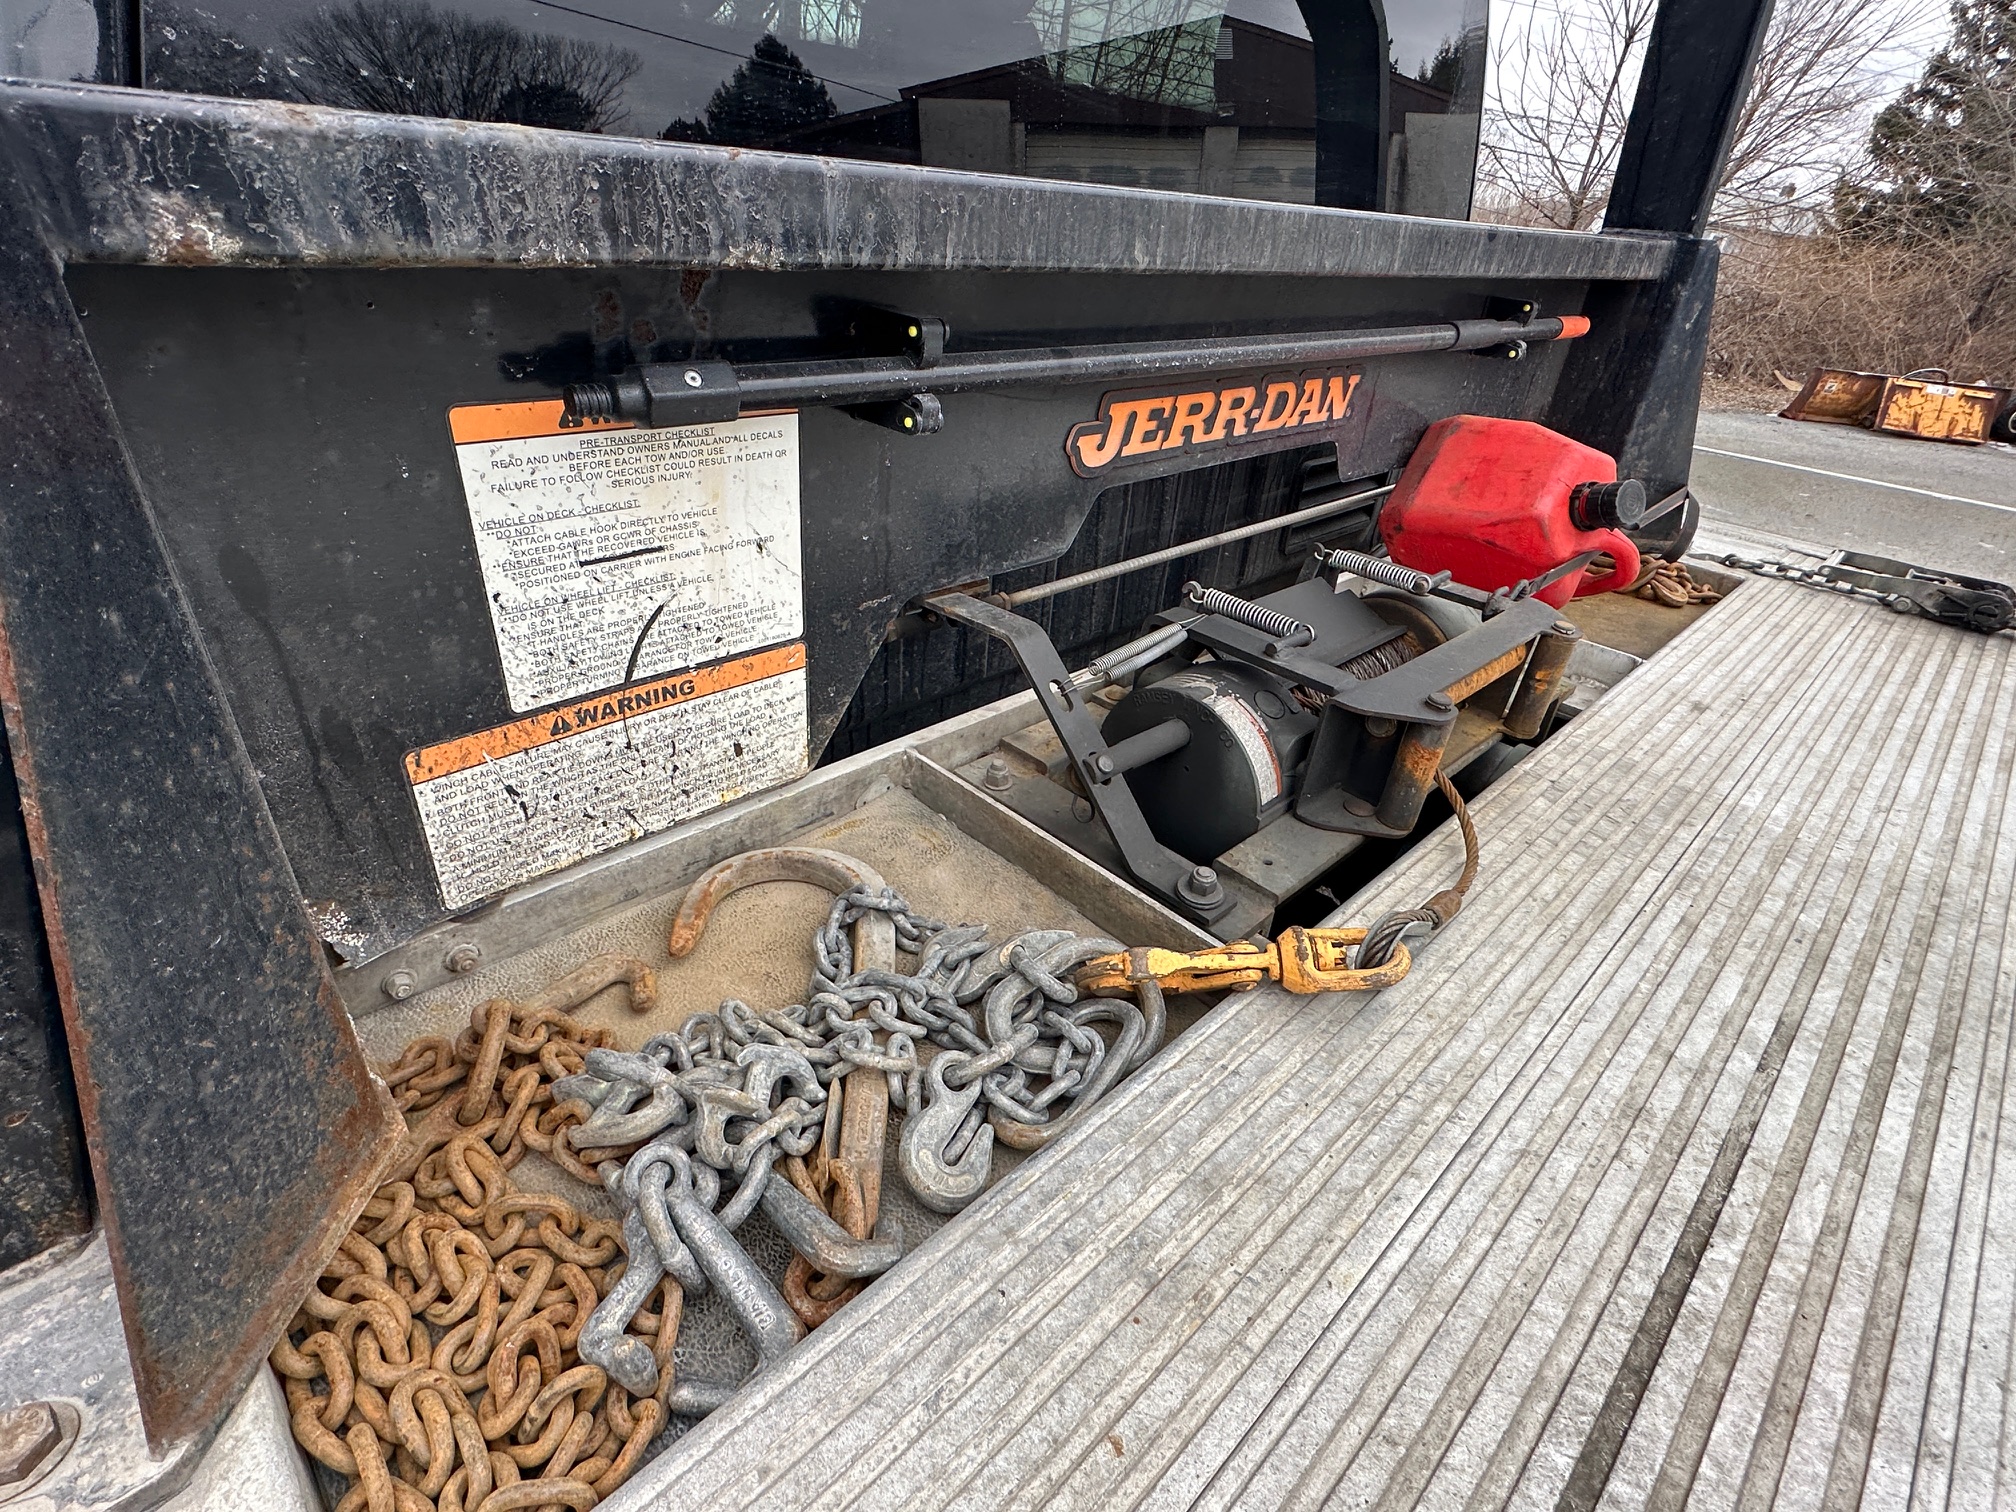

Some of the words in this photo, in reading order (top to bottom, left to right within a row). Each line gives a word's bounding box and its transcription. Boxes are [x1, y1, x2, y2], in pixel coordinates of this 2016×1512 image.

[579, 432, 662, 447] PRE-TRANSPORT
[664, 427, 715, 438] CHECKLIST
[1076, 374, 1361, 468] JERR-DAN
[491, 458, 523, 468] READ
[525, 455, 549, 464] AND
[551, 447, 624, 461] UNDERSTAND
[627, 442, 669, 453] OWNERS
[672, 438, 710, 448] MANUAL
[712, 436, 732, 444] AND
[732, 434, 747, 442] ALL
[750, 430, 783, 440] DECALS
[568, 460, 610, 471] BEFORE
[614, 456, 641, 465] EACH
[644, 453, 666, 462] TOW
[668, 449, 703, 459] AND/OR
[490, 479, 538, 492] FAILURE
[542, 477, 556, 485] TO
[559, 471, 603, 483] FOLLOW
[605, 464, 660, 478] CHECKLIST
[663, 460, 695, 470] COULD
[698, 455, 731, 466] RESULT
[746, 451, 772, 460] DEATH
[774, 449, 786, 457] OR
[610, 475, 654, 488] SERIOUS
[478, 516, 525, 529] VEHICLE
[528, 513, 544, 522] ON
[546, 508, 575, 519] DECK
[553, 528, 586, 539] CABLE
[589, 523, 617, 533] HOOK
[619, 515, 664, 529] DIRECTLY
[667, 513, 679, 521] TO
[680, 507, 717, 519] VEHICLE
[596, 535, 610, 543] OR
[612, 530, 642, 541] GCWR
[644, 528, 657, 536] OF
[659, 521, 697, 533] CHASSIS
[548, 551, 571, 561] THAT
[575, 547, 594, 556] THE
[597, 537, 655, 553] RECOVERED
[657, 530, 694, 542] VEHICLE
[583, 568, 598, 577] ON
[600, 560, 641, 573] CARRIER
[643, 555, 666, 565] WITH
[668, 548, 701, 560] ENGINE
[703, 542, 734, 554] FACING
[735, 534, 774, 548] FORWARD
[495, 599, 540, 615] VEHICLE
[542, 596, 558, 605] ON
[560, 589, 593, 601] WHEEL
[596, 584, 615, 594] LIFT
[529, 608, 551, 618] NOT
[553, 603, 573, 613] USE
[575, 596, 608, 608] WHEEL
[611, 591, 629, 601] LIFT
[631, 584, 661, 596] UNLESS
[677, 574, 711, 587] VEHICLE
[527, 621, 537, 629] IS
[540, 618, 554, 626] ON
[558, 613, 575, 622] THE
[578, 606, 605, 617] DECK
[560, 636, 597, 650] SAFETY
[599, 626, 635, 640] STRAPS
[657, 611, 702, 627] PROPERLY
[563, 645, 598, 660] SAFETY
[600, 636, 634, 650] CHAINS
[702, 618, 712, 626] TO
[715, 610, 742, 623] TOWED
[746, 603, 776, 615] VEHICLE
[586, 624, 605, 634] ARE
[658, 602, 704, 618] IGHTENED
[705, 626, 714, 634] TO
[746, 611, 777, 624] VEHICLE
[579, 659, 619, 675] GROUND
[676, 641, 692, 650] FOR
[725, 625, 757, 638] VEHICLE
[677, 651, 689, 659] ON
[722, 634, 754, 647] VEHICLE
[575, 678, 695, 727] WARNING
[430, 776, 468, 793] WINCH
[553, 743, 572, 754] MAY
[575, 731, 608, 747] CAUSE
[643, 717, 656, 726] OR
[712, 692, 739, 705] CLEAR
[740, 688, 751, 697] OF
[436, 799, 467, 815] BOTH
[468, 787, 506, 804] FRONT
[729, 708, 749, 720] LOAD
[442, 817, 485, 837] CLUTCH
[762, 709, 802, 728] OPERATION
[432, 790, 456, 804] AND
[459, 780, 489, 795] LOAD
[439, 814, 456, 825] DO
[458, 806, 480, 818] NOT
[483, 796, 509, 810] RELY
[530, 782, 551, 794] THE
[552, 771, 583, 787] WINCH
[585, 765, 599, 776] AS
[600, 759, 617, 770] THE
